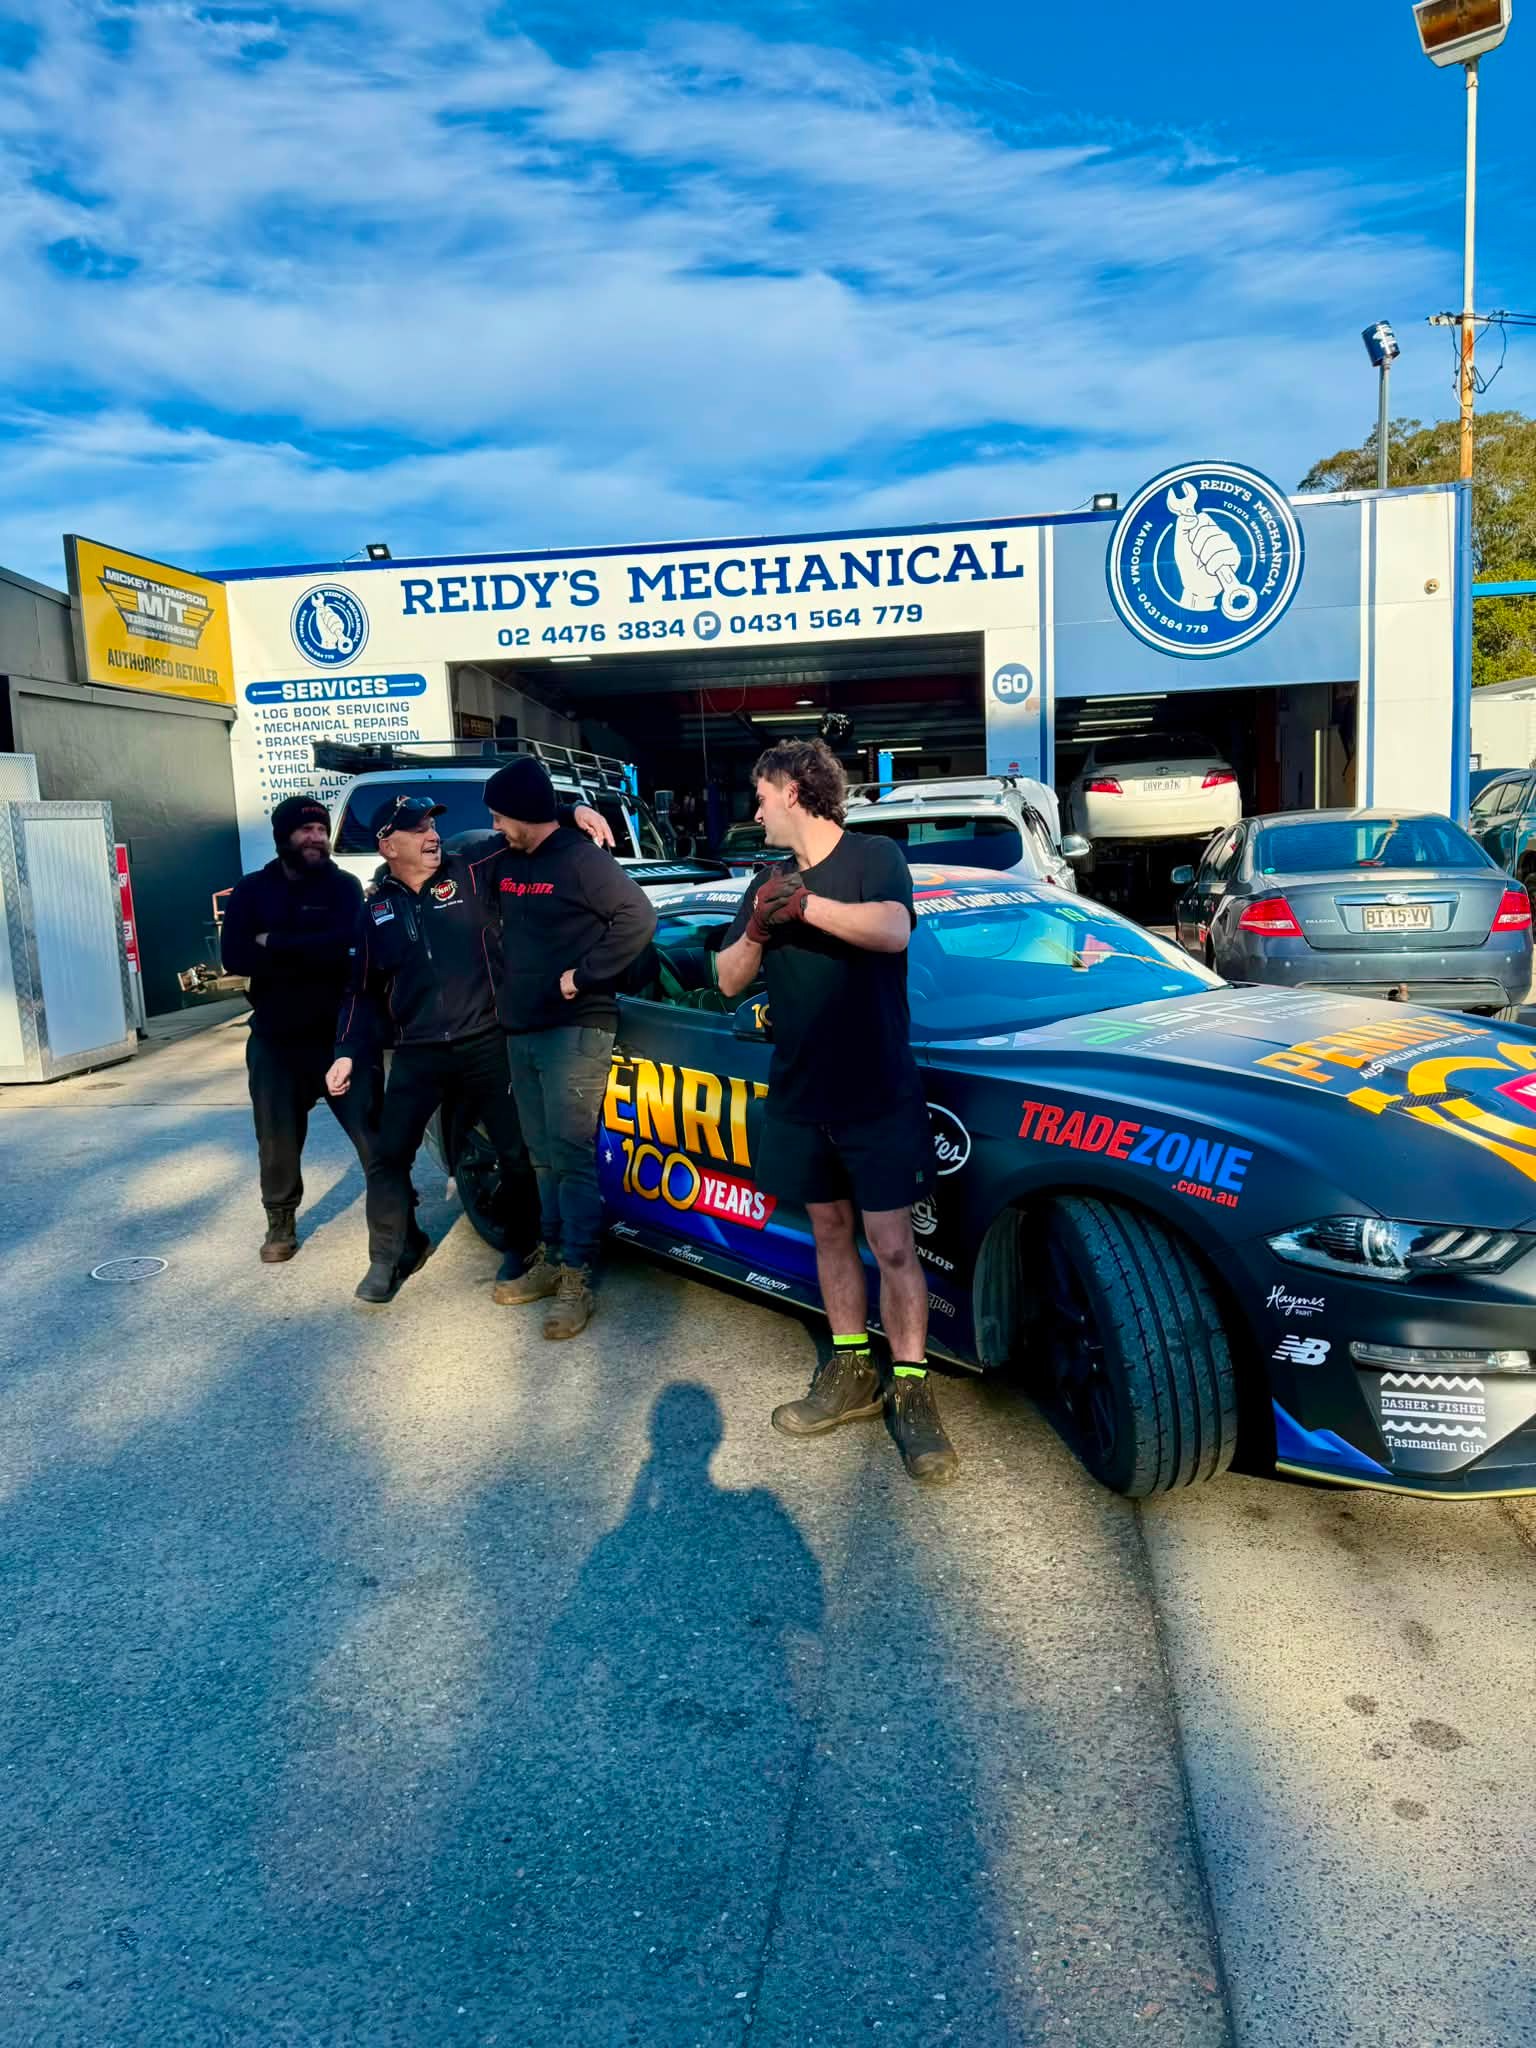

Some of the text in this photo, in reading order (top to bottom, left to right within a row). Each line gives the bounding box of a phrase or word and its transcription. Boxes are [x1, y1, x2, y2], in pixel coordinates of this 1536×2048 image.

[1200, 480, 1282, 595] REIDY'S MECHANICAL
[1223, 501, 1266, 564] TOYOTA SPECIALIST
[1131, 520, 1153, 585] NAROOMA
[105, 568, 206, 607] MICKEY THOMPSON
[401, 569, 600, 615] REIDY'S
[627, 541, 1024, 604] MECHANICAL
[137, 592, 188, 624] M/T
[1138, 593, 1160, 619] 0431
[498, 628, 530, 647] 02
[541, 623, 606, 645] 4476
[618, 618, 685, 641] 3834
[730, 612, 798, 634] 0431
[809, 607, 861, 630] 564
[874, 604, 923, 625] 779
[1160, 615, 1183, 631] 564
[1185, 624, 1208, 633] 779
[108, 648, 219, 686] AUTHORISED RETAILER
[282, 678, 388, 700] SERVICES
[997, 673, 1028, 694] 60
[262, 702, 410, 719] LOG BOOK SERVICING
[264, 716, 409, 733] MECHANICAL REPAIRS
[265, 735, 317, 747] BRAKES
[336, 730, 420, 744] SUSPENSION
[267, 749, 309, 761] TYRES
[270, 776, 314, 789] WHEEL
[706, 892, 742, 903] TANDER
[1252, 1016, 1493, 1083] PENRITE
[1359, 1047, 1421, 1079] AUSTRALIAN
[1018, 1100, 1253, 1192] TRADEZONE
[703, 1175, 766, 1221] YEARS
[1171, 1179, 1240, 1208] .com.au
[915, 1244, 954, 1271] NLOP
[1266, 1285, 1326, 1315] Haymes
[1385, 1435, 1484, 1454] Tasmanian Gin
